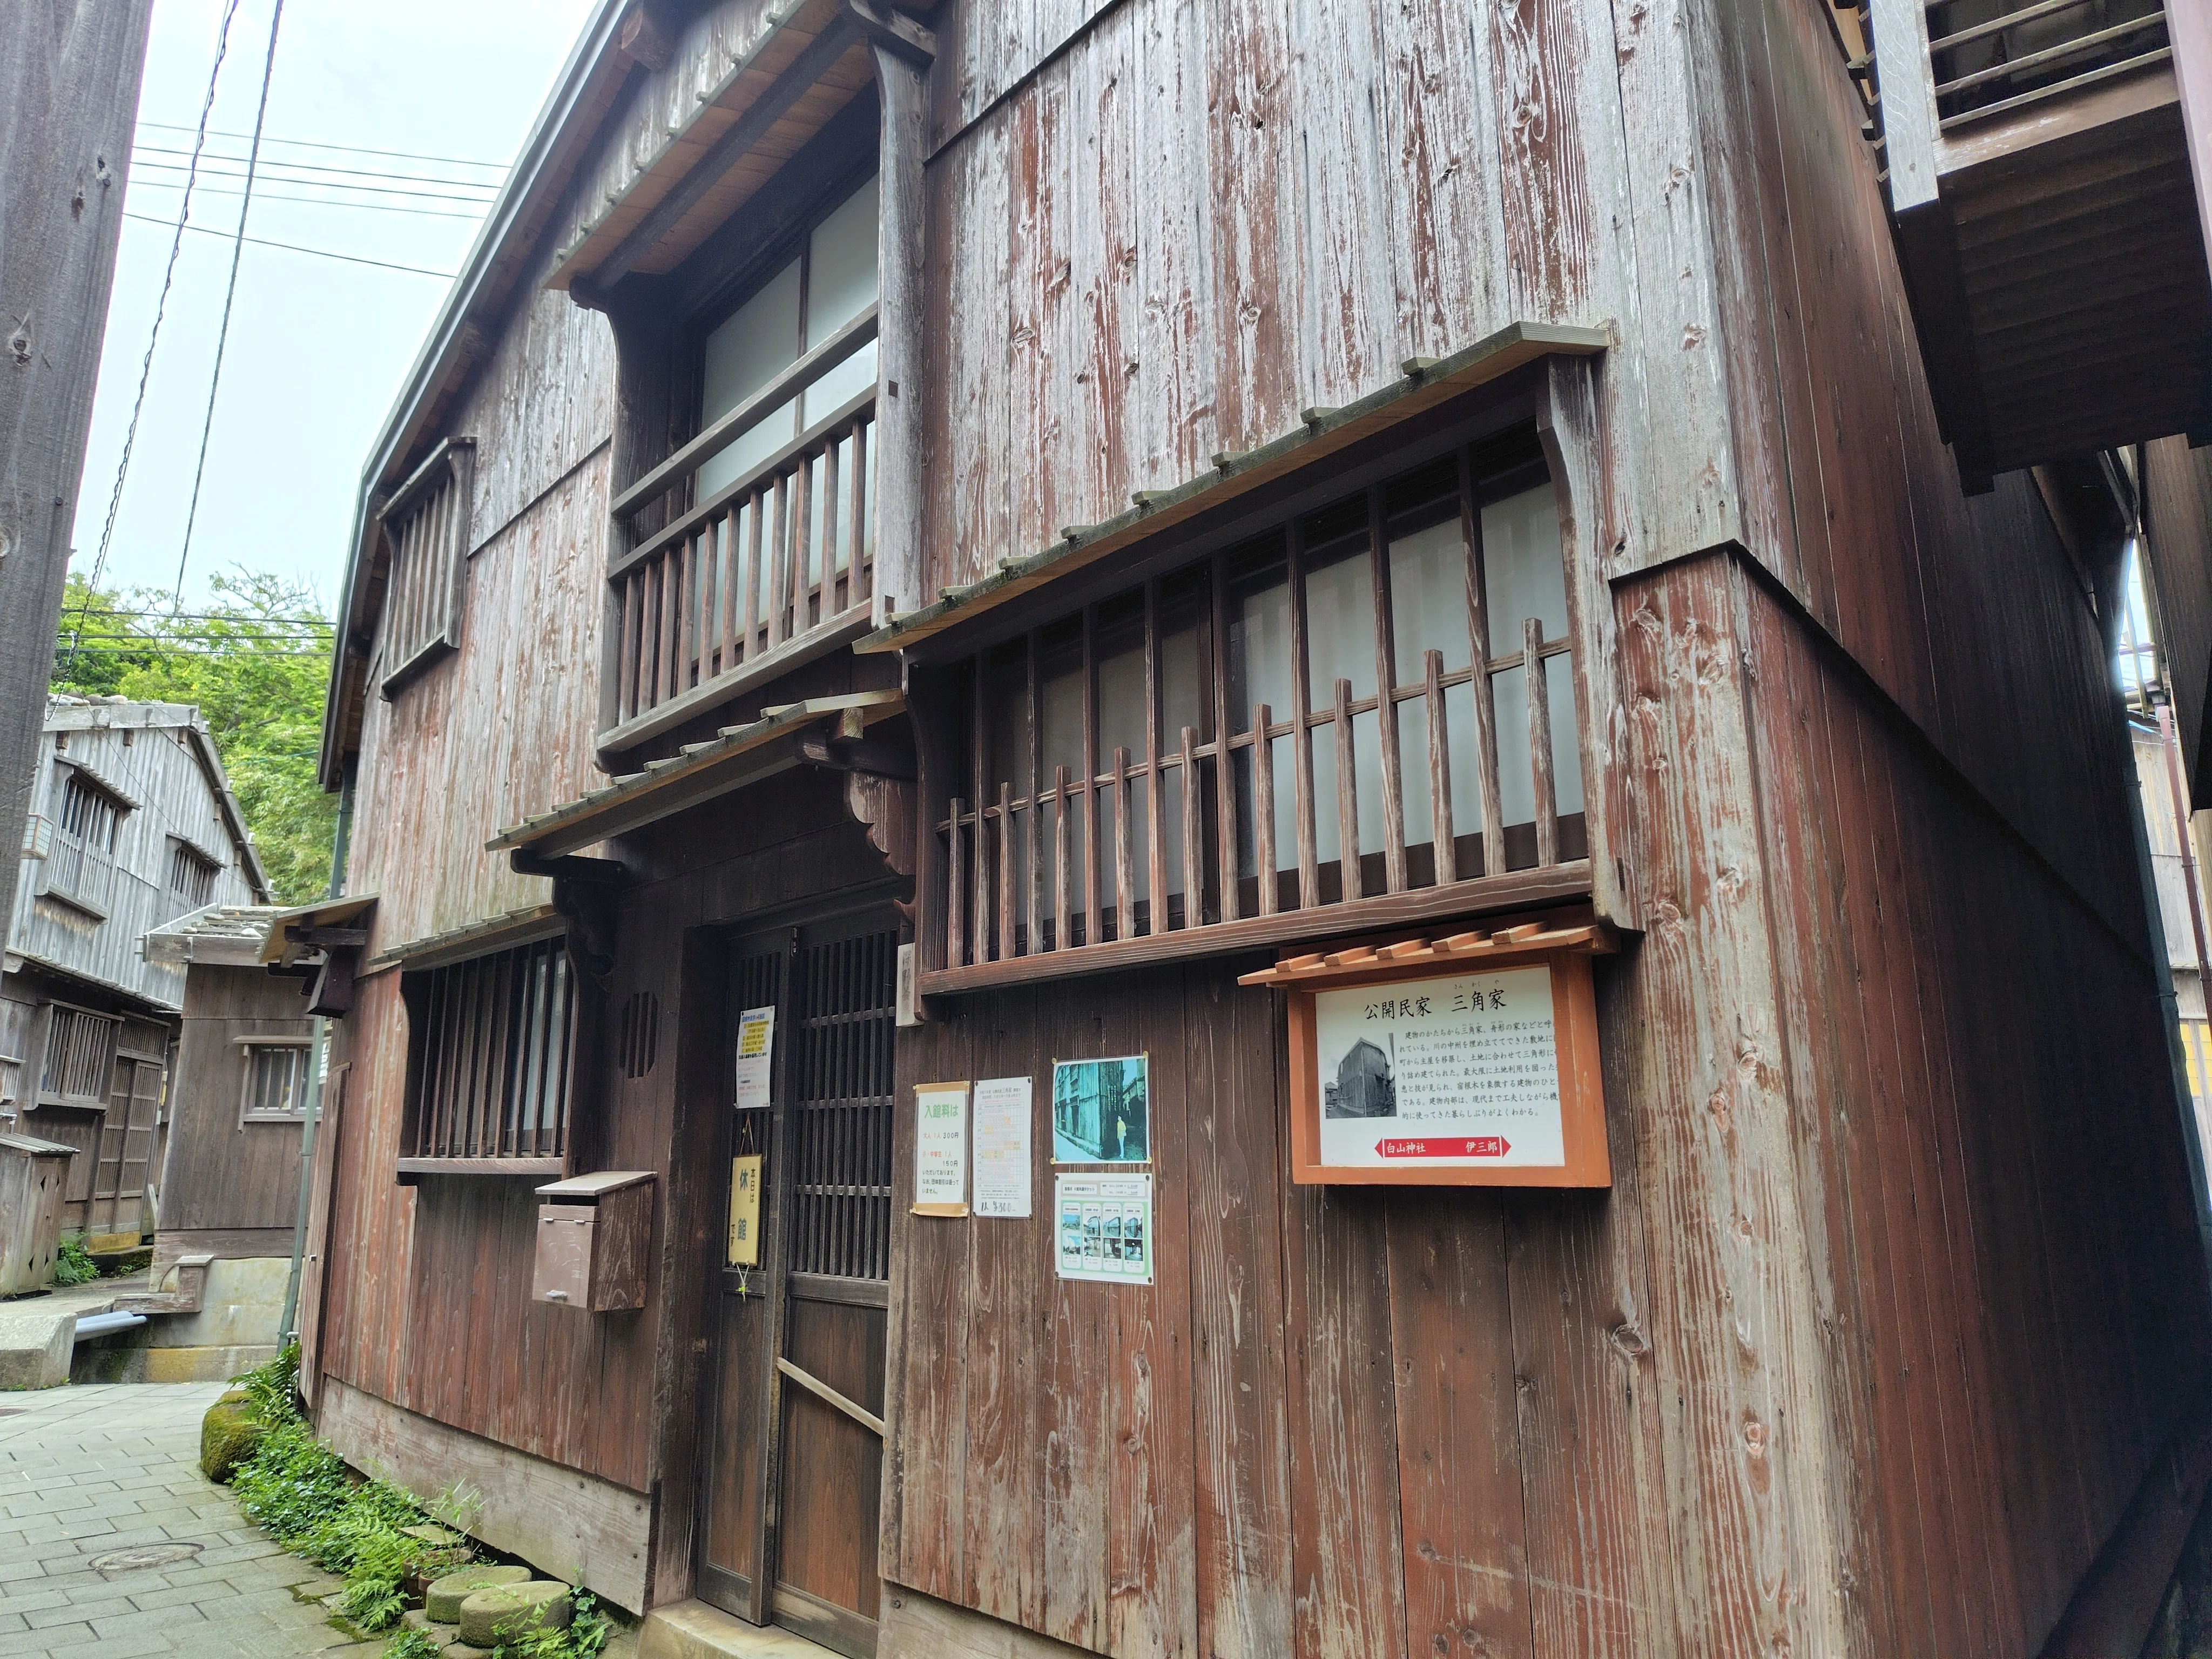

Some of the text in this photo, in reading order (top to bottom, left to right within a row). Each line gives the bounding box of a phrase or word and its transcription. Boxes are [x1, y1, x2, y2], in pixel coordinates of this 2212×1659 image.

[1364, 989, 1507, 1020] 公開民家 三角家
[1405, 1020, 1555, 1039] 建物のかたちから三角家、舟形の家などと呼
[1400, 1035, 1555, 1053] れている。川の中州を埋め立ててできた敷地に
[925, 1104, 959, 1118] 入館料は
[1387, 1141, 1498, 1155] 白山神社 伊三郎
[737, 1169, 748, 1240] 休館
[730, 1223, 736, 1246] です
